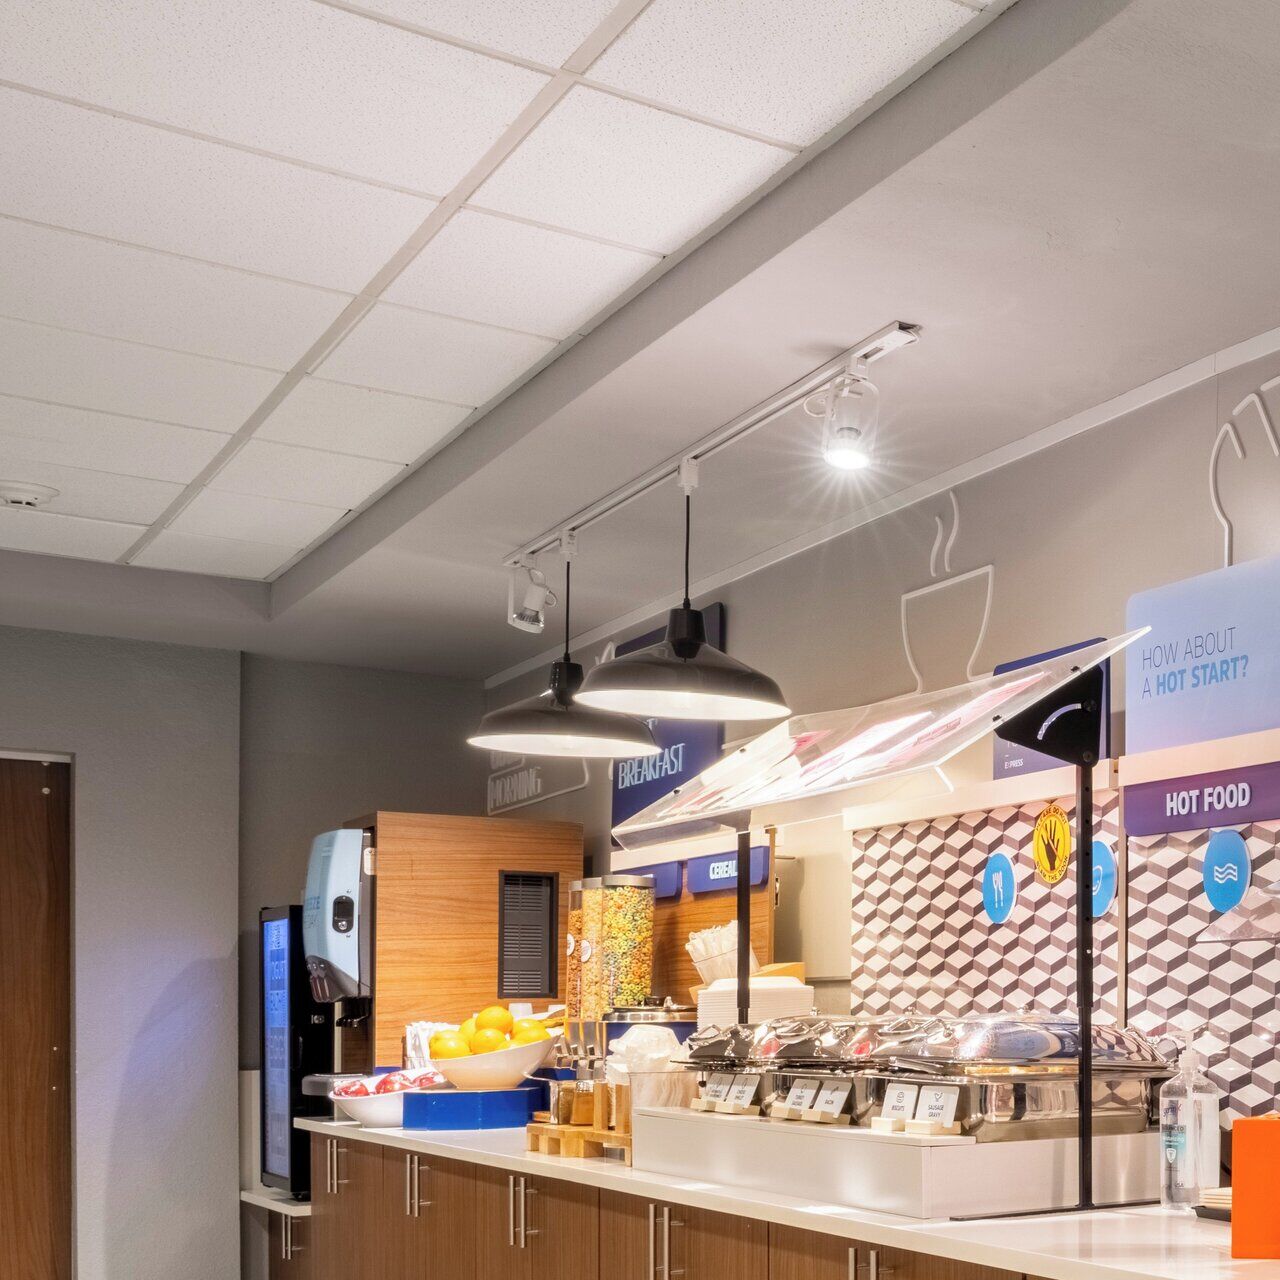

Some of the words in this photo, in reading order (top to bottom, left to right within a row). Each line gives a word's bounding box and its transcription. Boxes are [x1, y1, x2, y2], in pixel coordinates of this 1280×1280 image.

[1142, 641, 1179, 671] HOW
[1183, 626, 1237, 661] ABOUT
[1142, 676, 1152, 699] A
[1156, 667, 1187, 696] HOT
[1191, 654, 1250, 688] START?
[490, 766, 542, 810] MORNING
[618, 743, 686, 790] BREAKFAST
[1166, 789, 1200, 817] HOT
[1203, 782, 1252, 812] FOOD
[1058, 856, 1068, 876] DOOR
